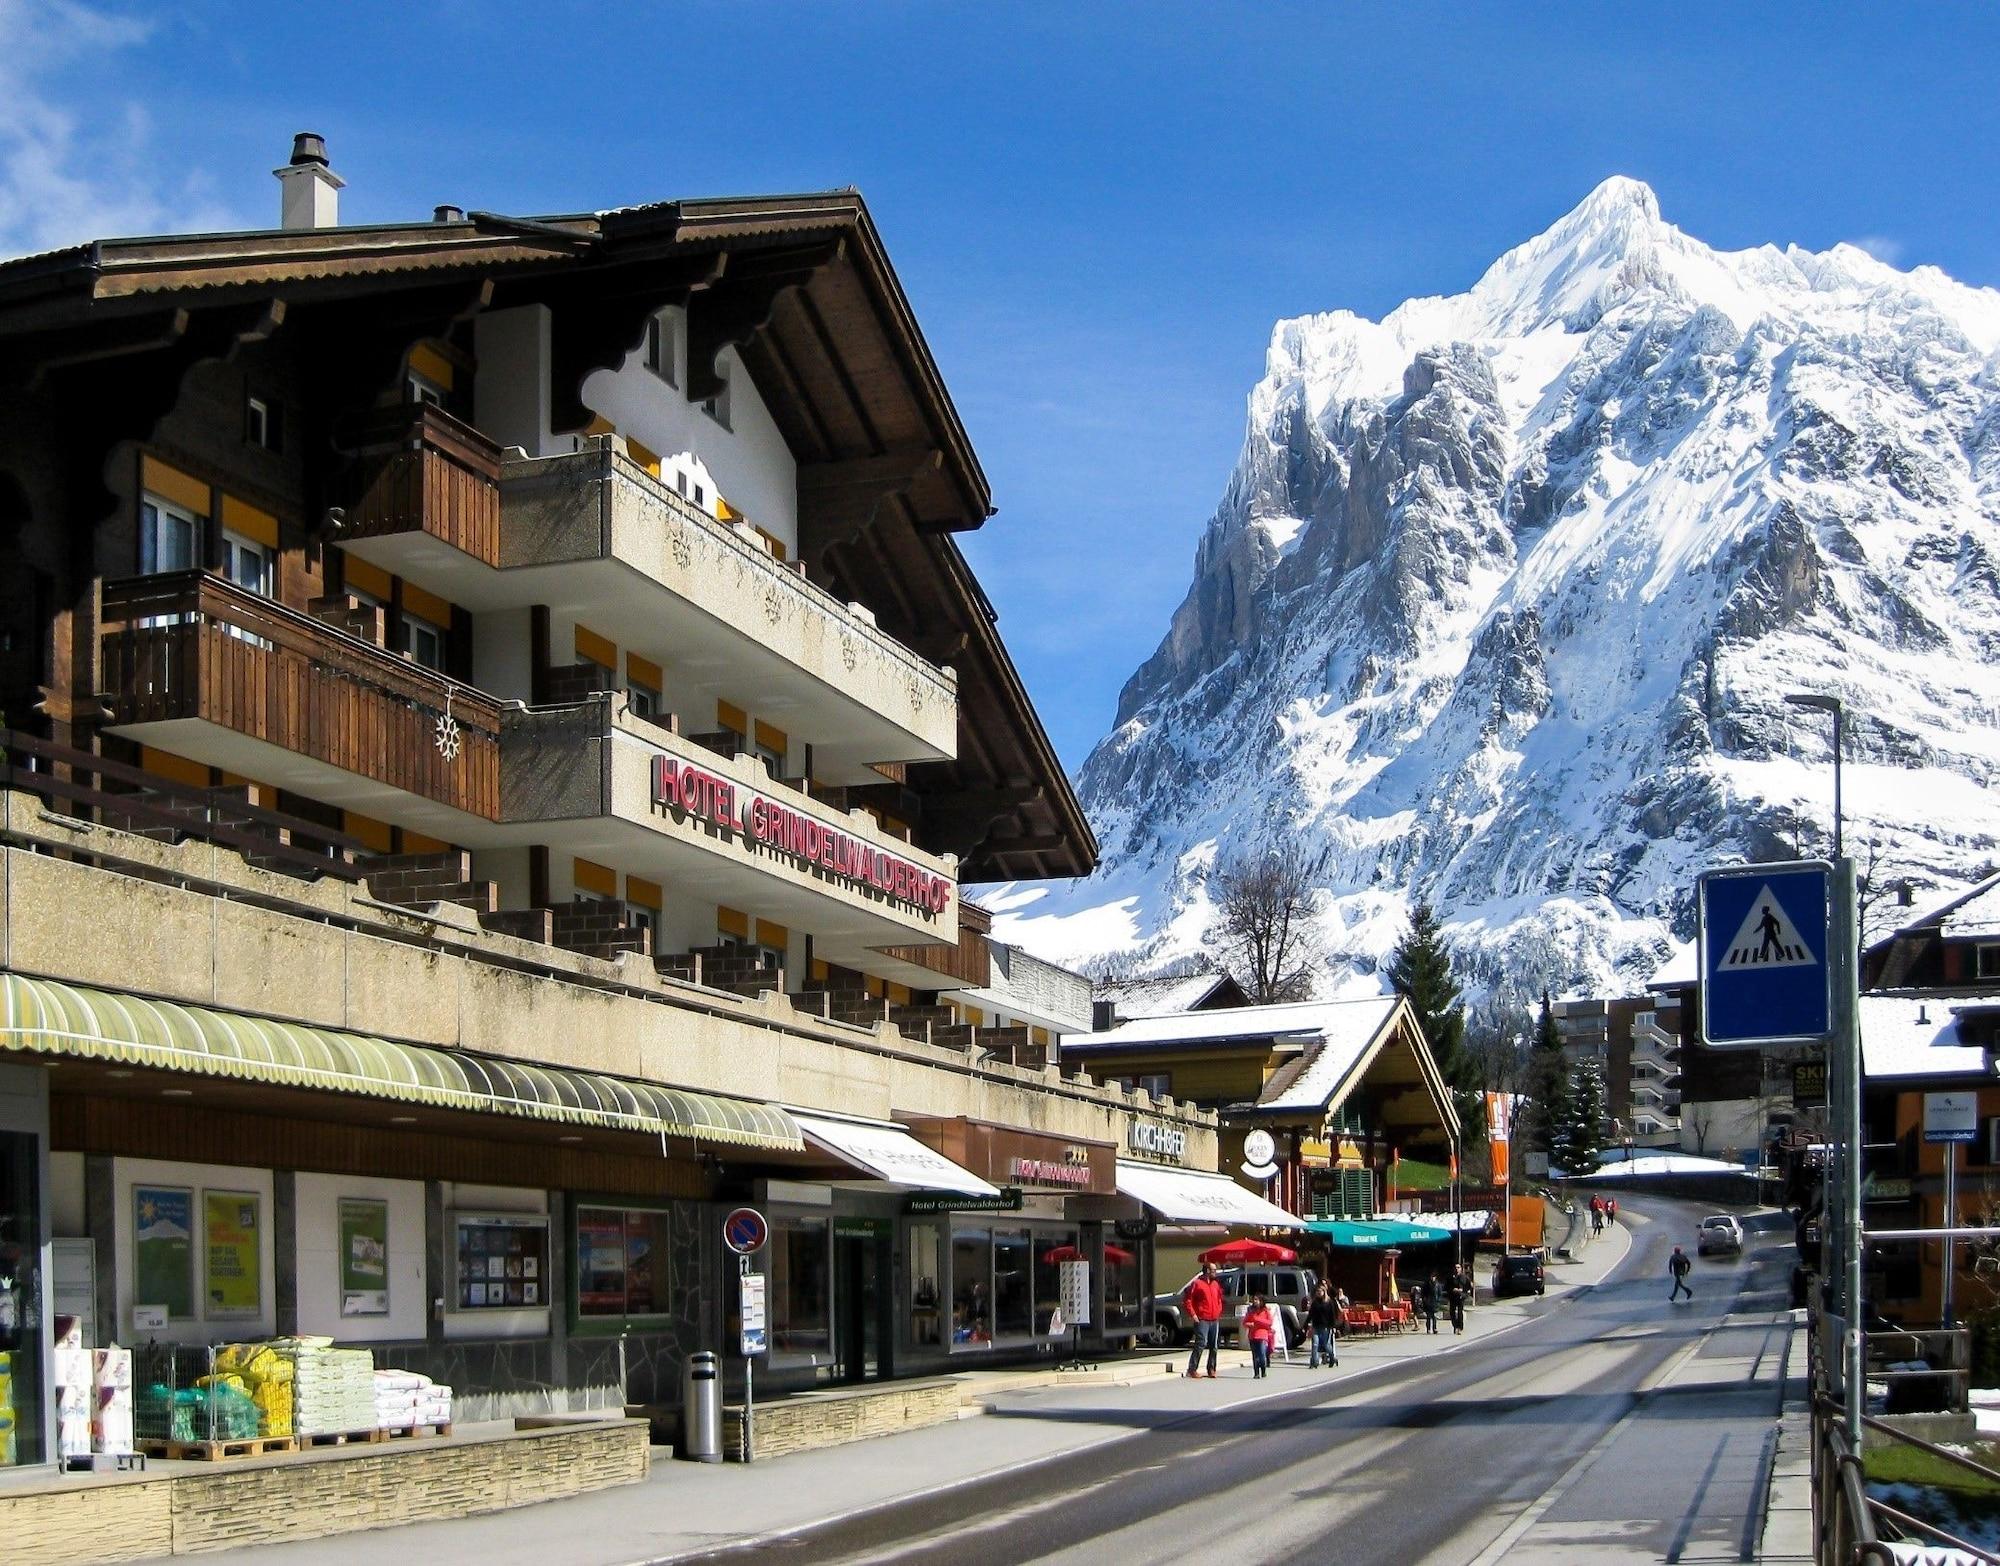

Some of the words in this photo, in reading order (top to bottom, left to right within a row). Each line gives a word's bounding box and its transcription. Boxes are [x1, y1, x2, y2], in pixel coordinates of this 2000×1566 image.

[658, 754, 743, 831] HOTEL
[750, 796, 950, 914] GRINDELWALDERHOF
[1796, 1066, 1824, 1079] SKI
[1134, 1121, 1186, 1156] KIRCHHOFER
[911, 1201, 935, 1210] Hotel
[938, 1200, 1014, 1210] Grindelwalderhof
